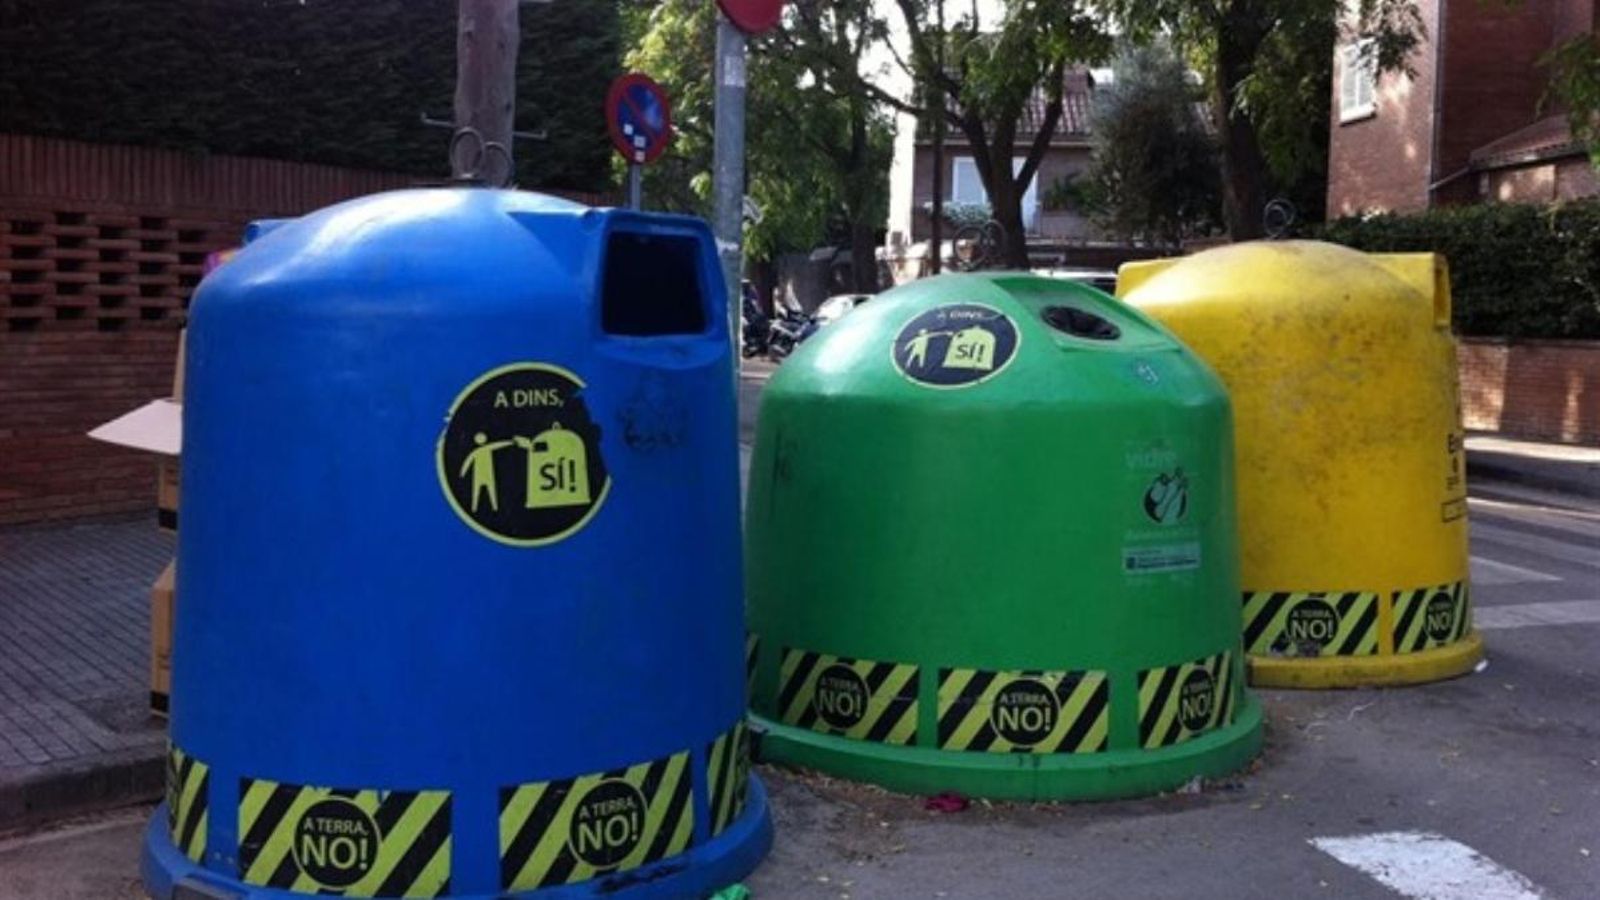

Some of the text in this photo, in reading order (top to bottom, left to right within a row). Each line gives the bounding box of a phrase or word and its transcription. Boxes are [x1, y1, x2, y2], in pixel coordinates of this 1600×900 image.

[493, 388, 565, 408] A DINS,
[539, 456, 577, 493] SÍ!
[1291, 618, 1334, 639] NO!
[819, 688, 862, 718] NO!
[999, 705, 1051, 732] NO!
[303, 817, 315, 832] A
[578, 804, 591, 821] A
[577, 811, 639, 854] NO!
[302, 834, 369, 871] NO!
